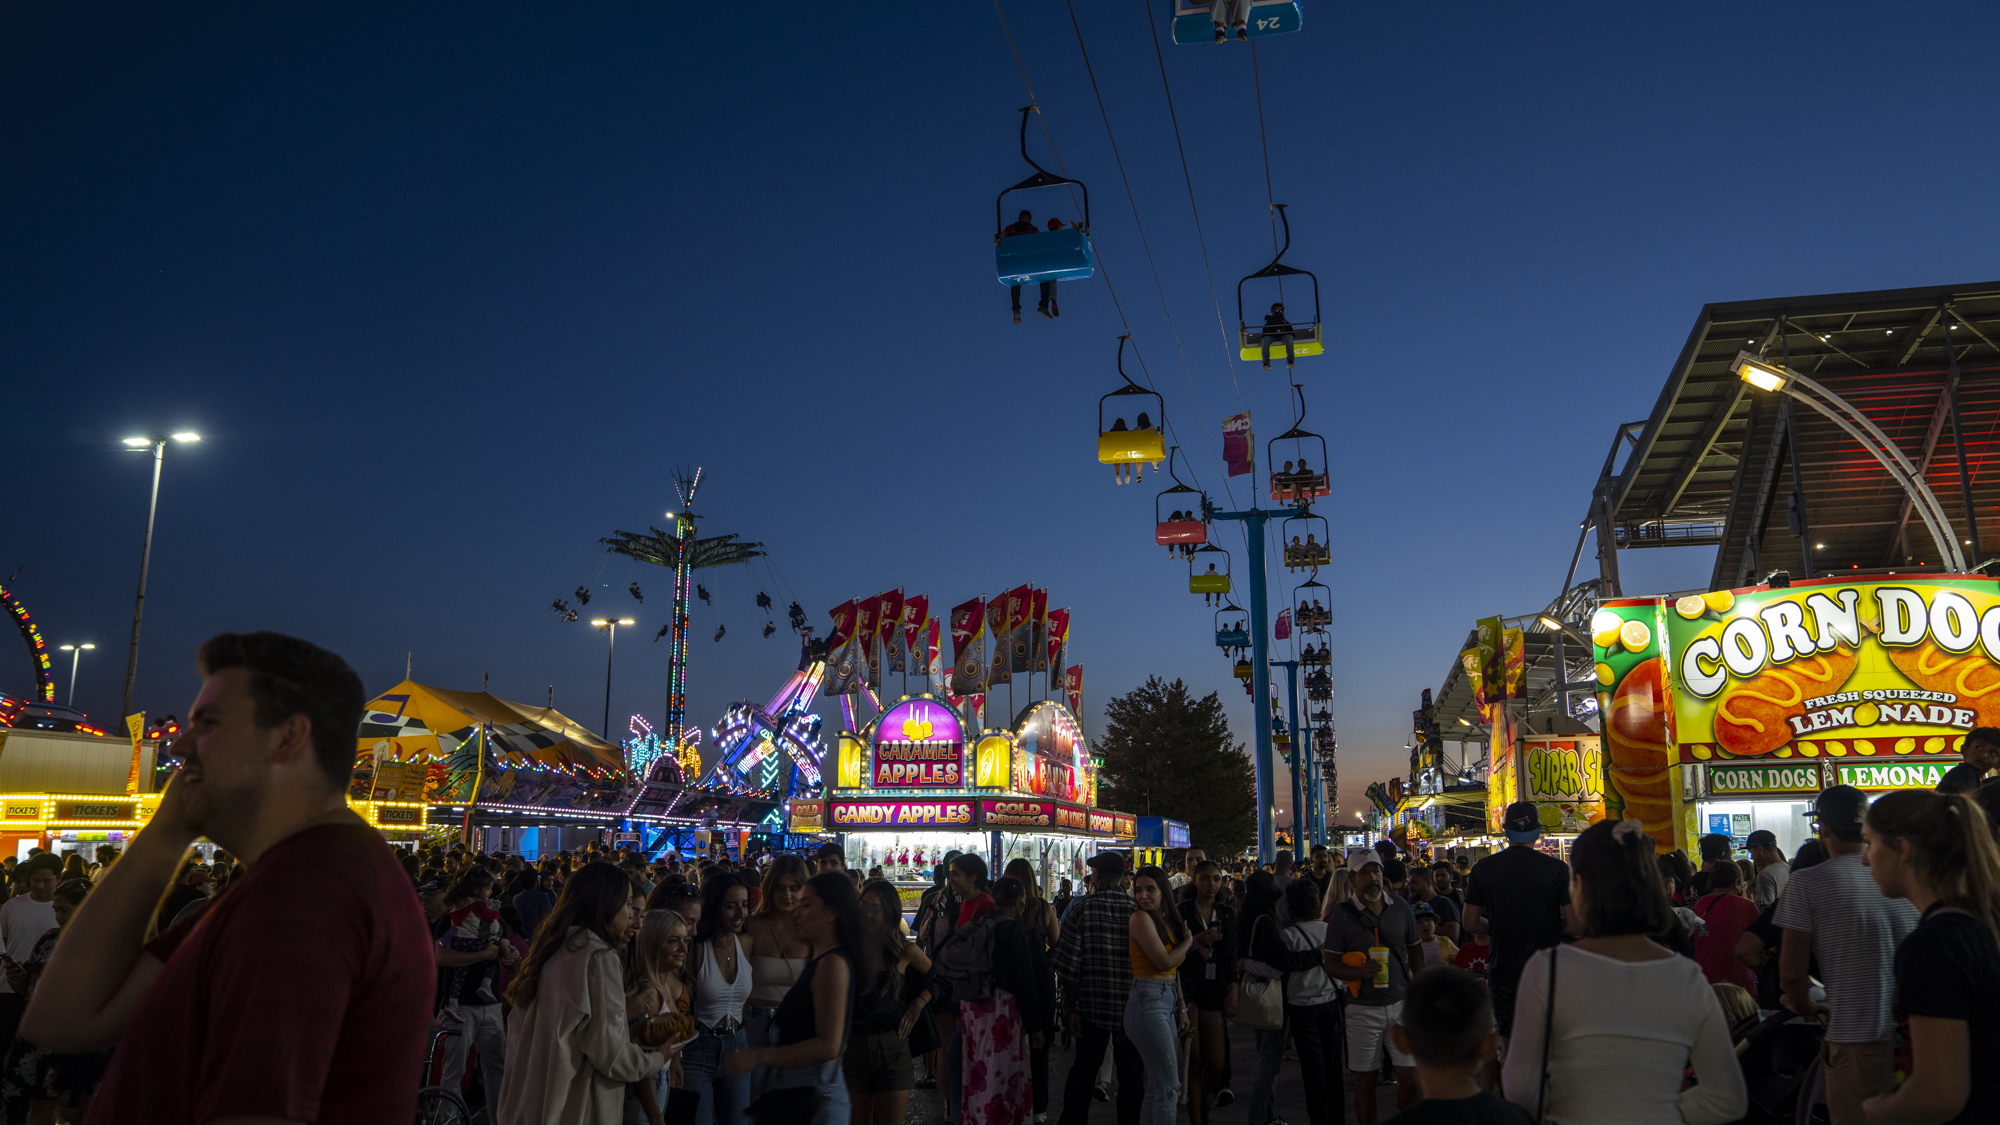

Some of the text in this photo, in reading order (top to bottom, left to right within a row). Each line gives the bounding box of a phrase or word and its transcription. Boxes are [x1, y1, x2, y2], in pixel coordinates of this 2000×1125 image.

[1256, 16, 1280, 30] 24
[1682, 588, 1861, 697] CORN
[1804, 689, 1957, 710] FRESH SQUEEZED
[1038, 718, 1073, 758] COTTON
[879, 738, 958, 761] CARAMEL
[877, 763, 959, 784] APPLES
[1040, 762, 1070, 798] CANDY
[1529, 747, 1582, 796] SUPER
[1714, 768, 1817, 790] CORN DOGS
[1840, 766, 1957, 787] LEMONA
[8, 806, 38, 816] TICKETS
[72, 803, 120, 818] TICKETS
[384, 809, 415, 821] TICKETS
[796, 804, 818, 815] COLD
[834, 804, 970, 824] CANDY APPLES
[994, 802, 1042, 814] COLD
[1057, 807, 1086, 829] SNO KONES
[791, 814, 821, 826] DRINKS
[986, 812, 1050, 826] DRINKS
[1090, 814, 1113, 832] POPCORN
